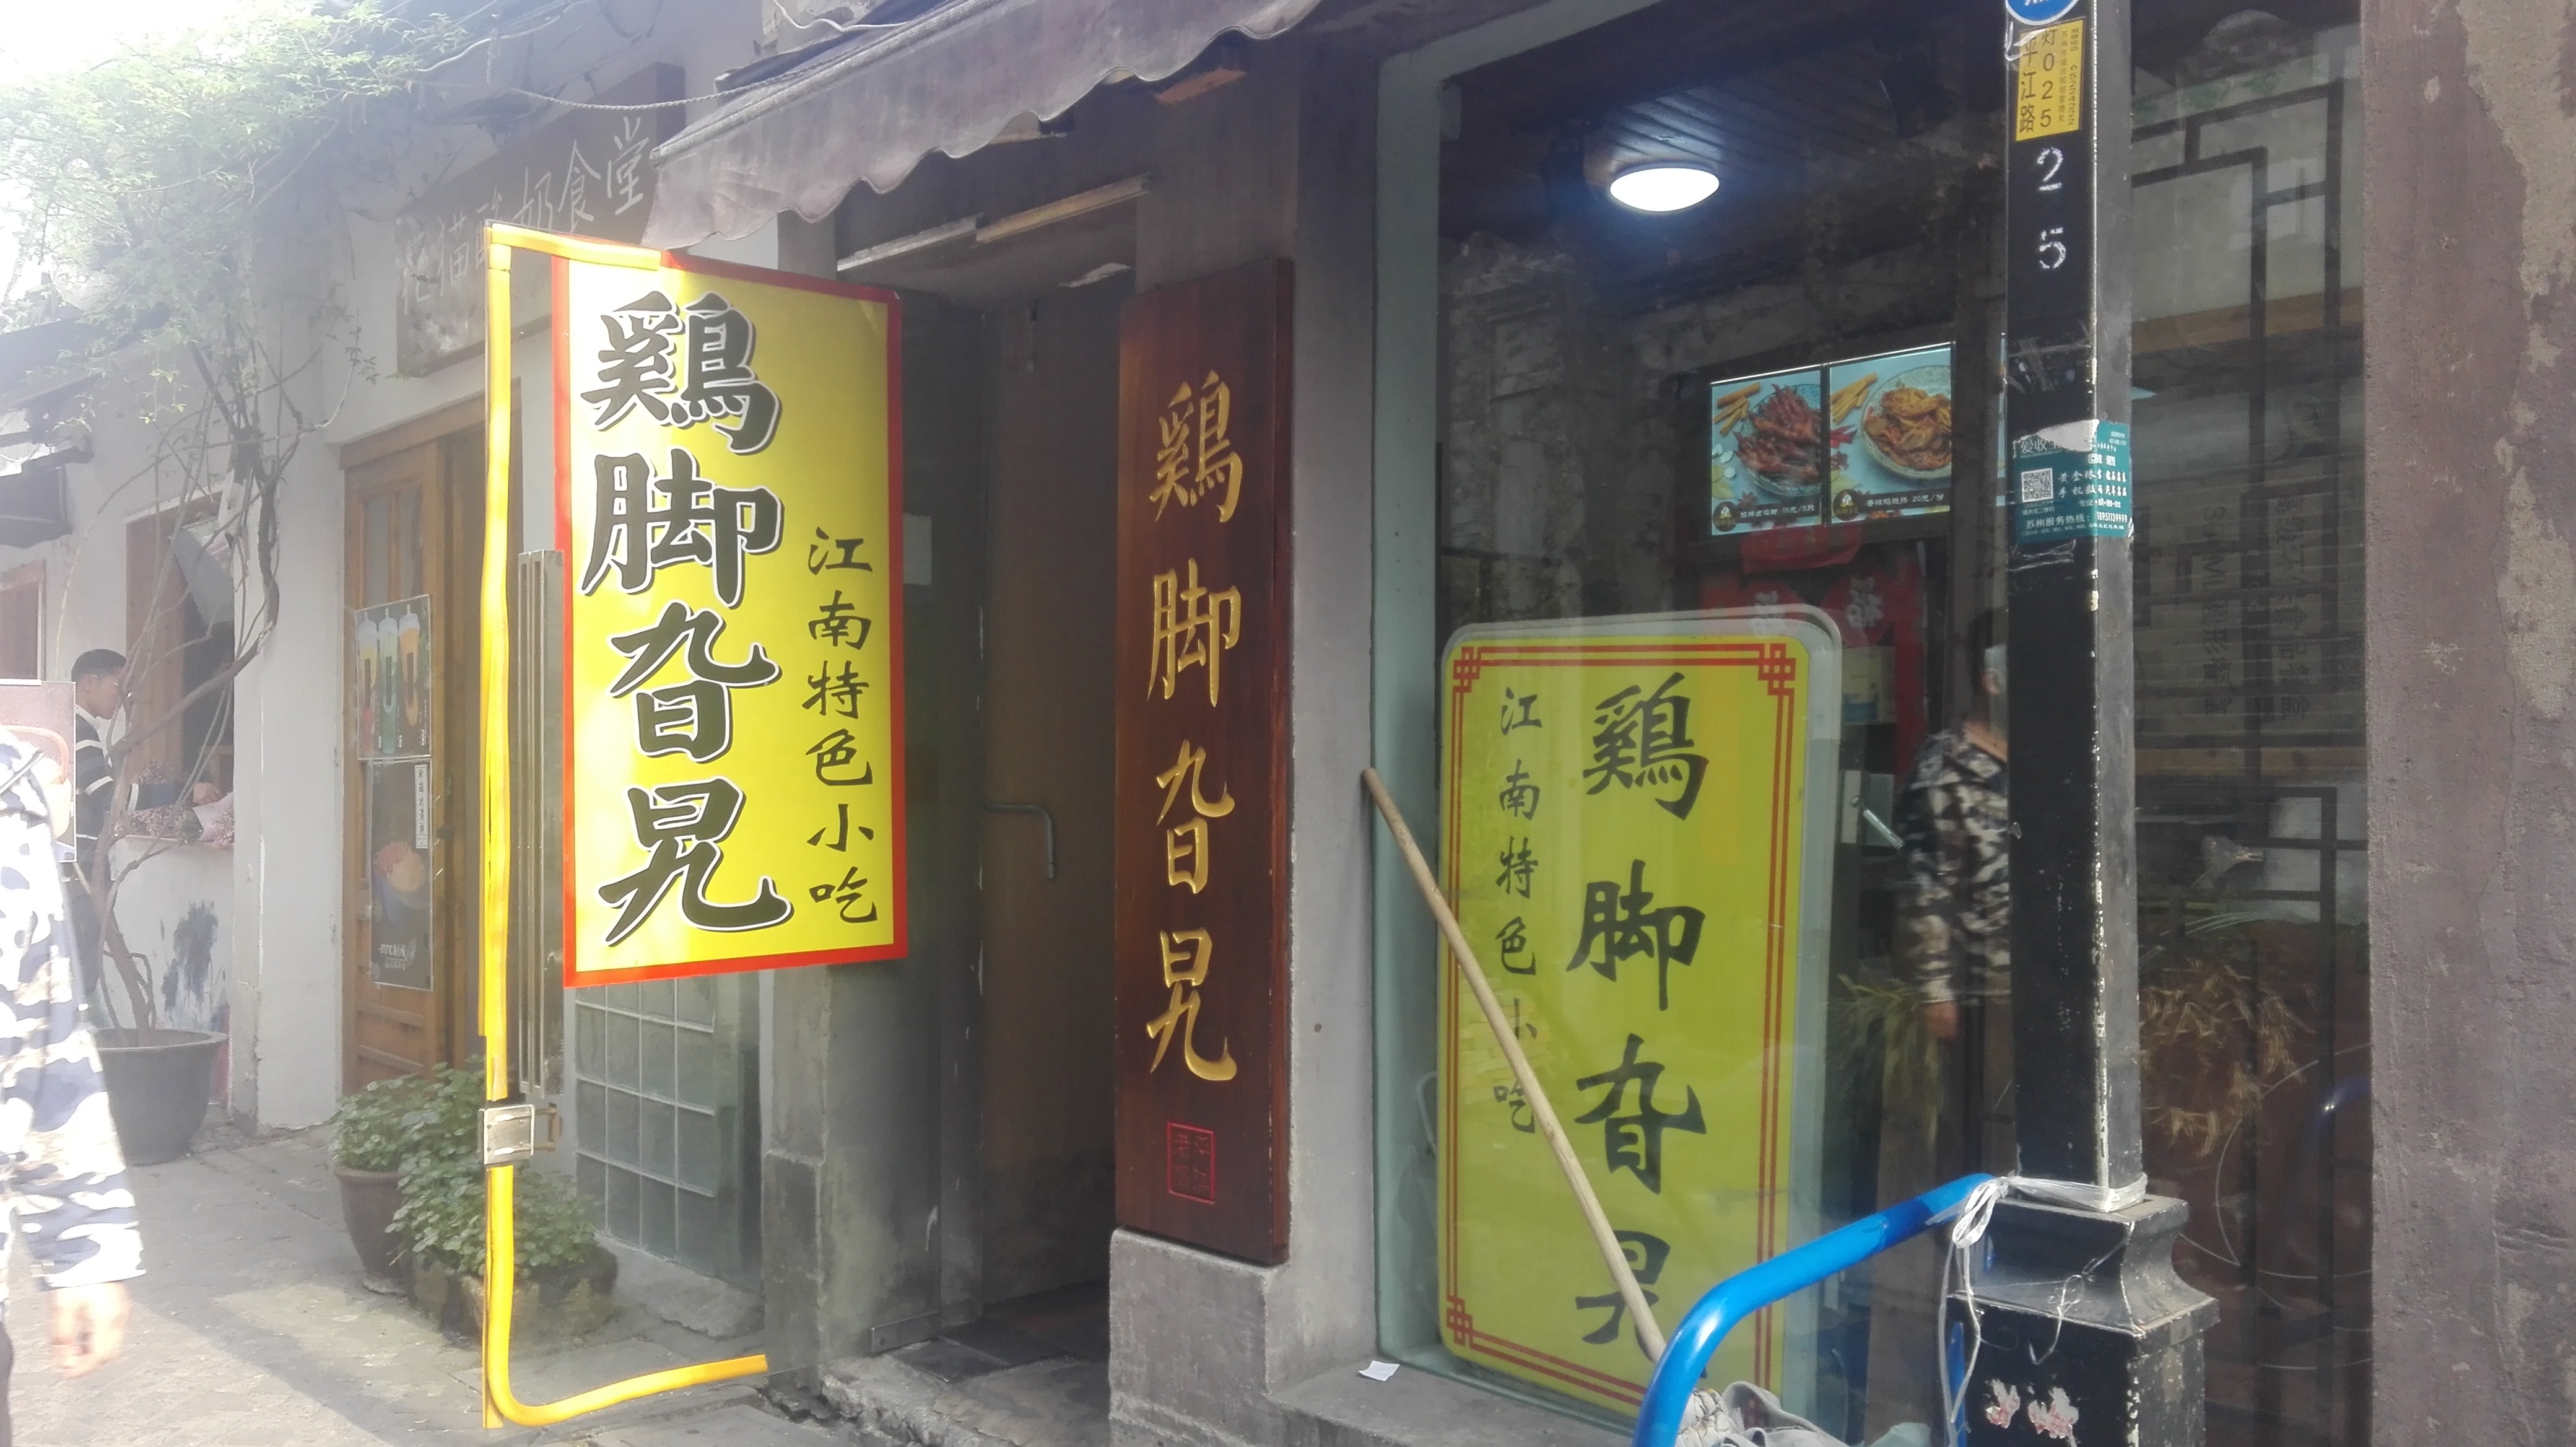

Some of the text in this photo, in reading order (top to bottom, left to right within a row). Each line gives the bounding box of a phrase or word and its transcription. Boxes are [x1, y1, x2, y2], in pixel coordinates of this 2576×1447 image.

[2019, 36, 2038, 134] 平江路
[2021, 439, 2057, 454] 爱收
[801, 526, 878, 924] 江南特色小吃
[1494, 686, 1543, 1134] 江南特色小吃
